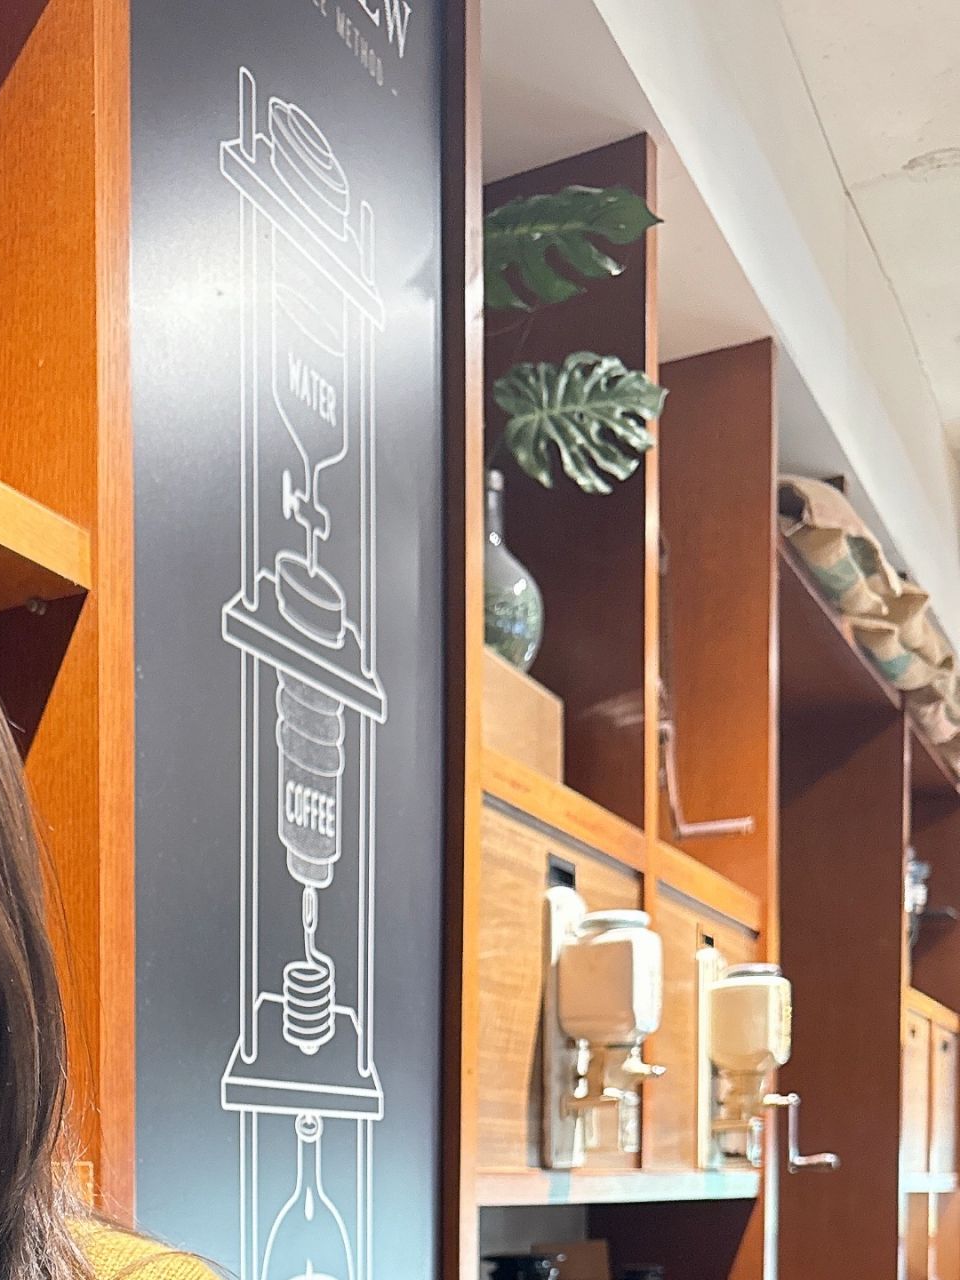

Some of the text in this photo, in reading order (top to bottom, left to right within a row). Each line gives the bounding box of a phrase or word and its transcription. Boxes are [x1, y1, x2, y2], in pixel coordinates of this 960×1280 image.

[335, 5, 385, 87] METHOD
[287, 350, 337, 428] WATER
[285, 780, 336, 838] COFFEE
